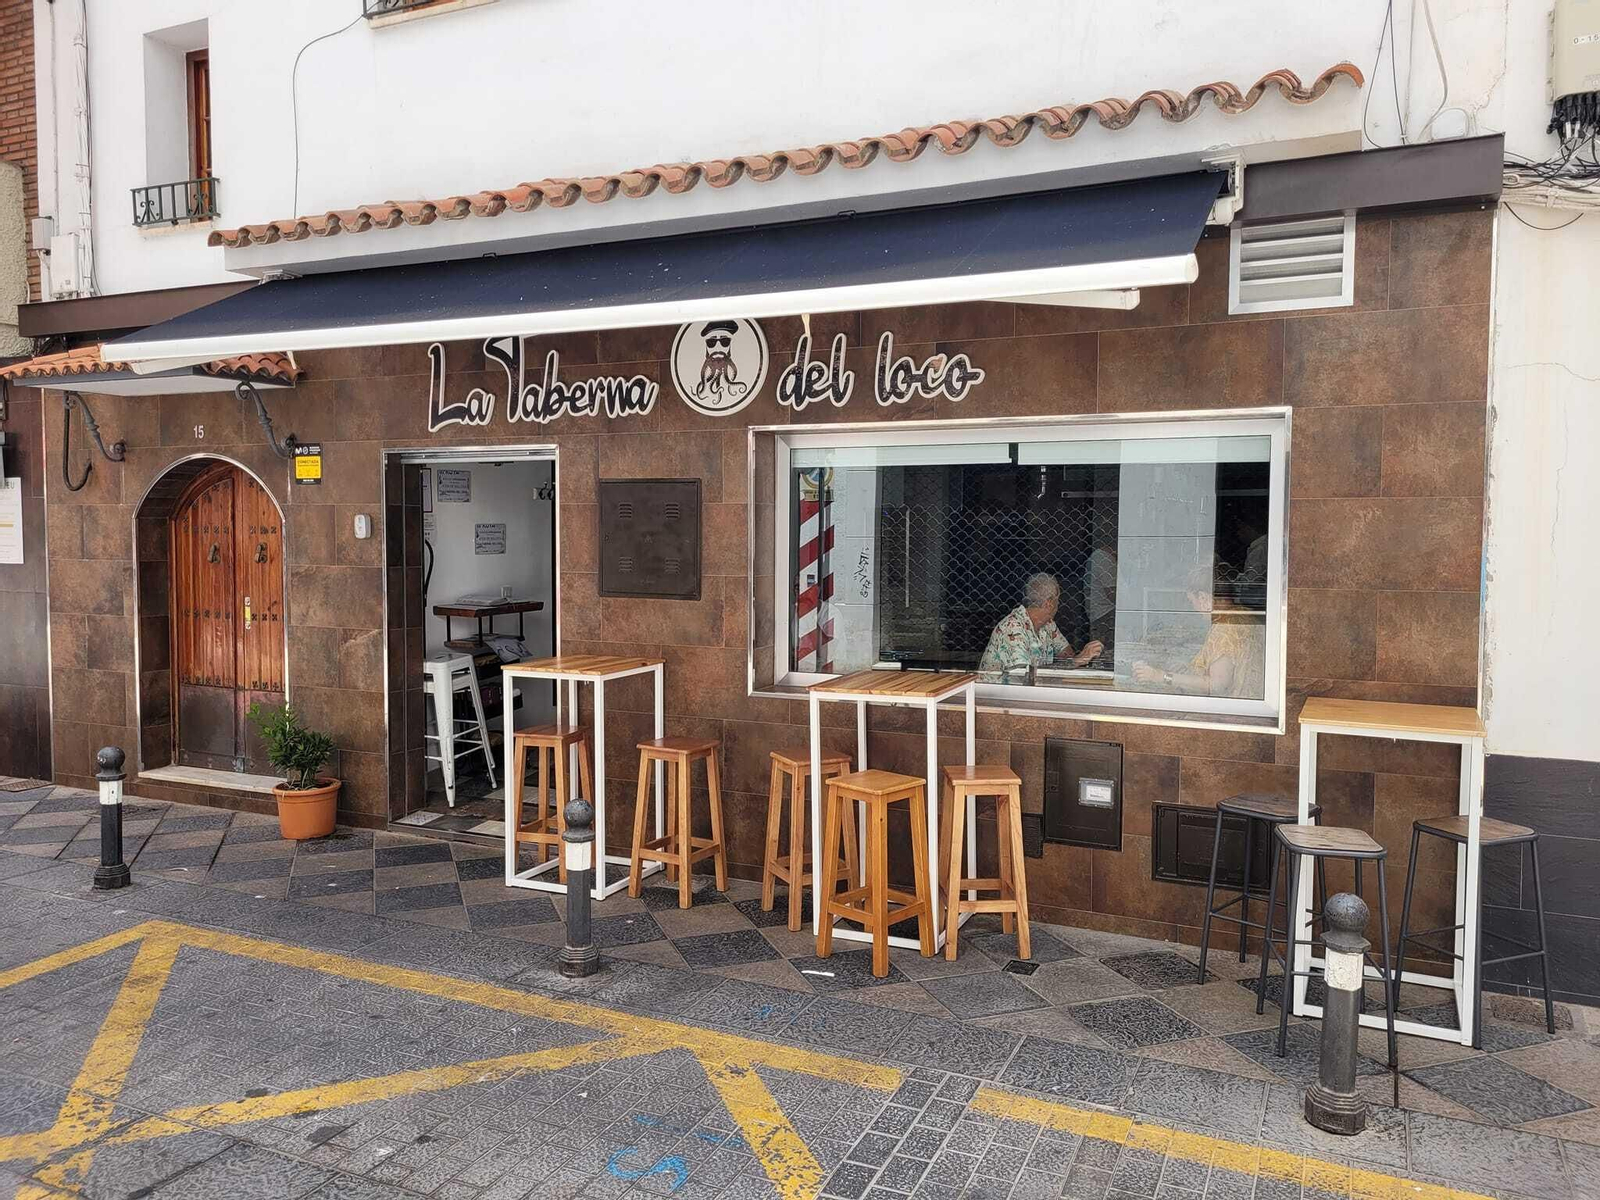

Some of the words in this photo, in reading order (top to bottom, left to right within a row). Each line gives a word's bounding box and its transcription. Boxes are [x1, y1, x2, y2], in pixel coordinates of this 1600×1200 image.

[428, 343, 495, 432] La
[483, 335, 659, 424] Taberna
[777, 332, 854, 411] del
[875, 331, 985, 406] loco
[193, 425, 205, 439] 15
